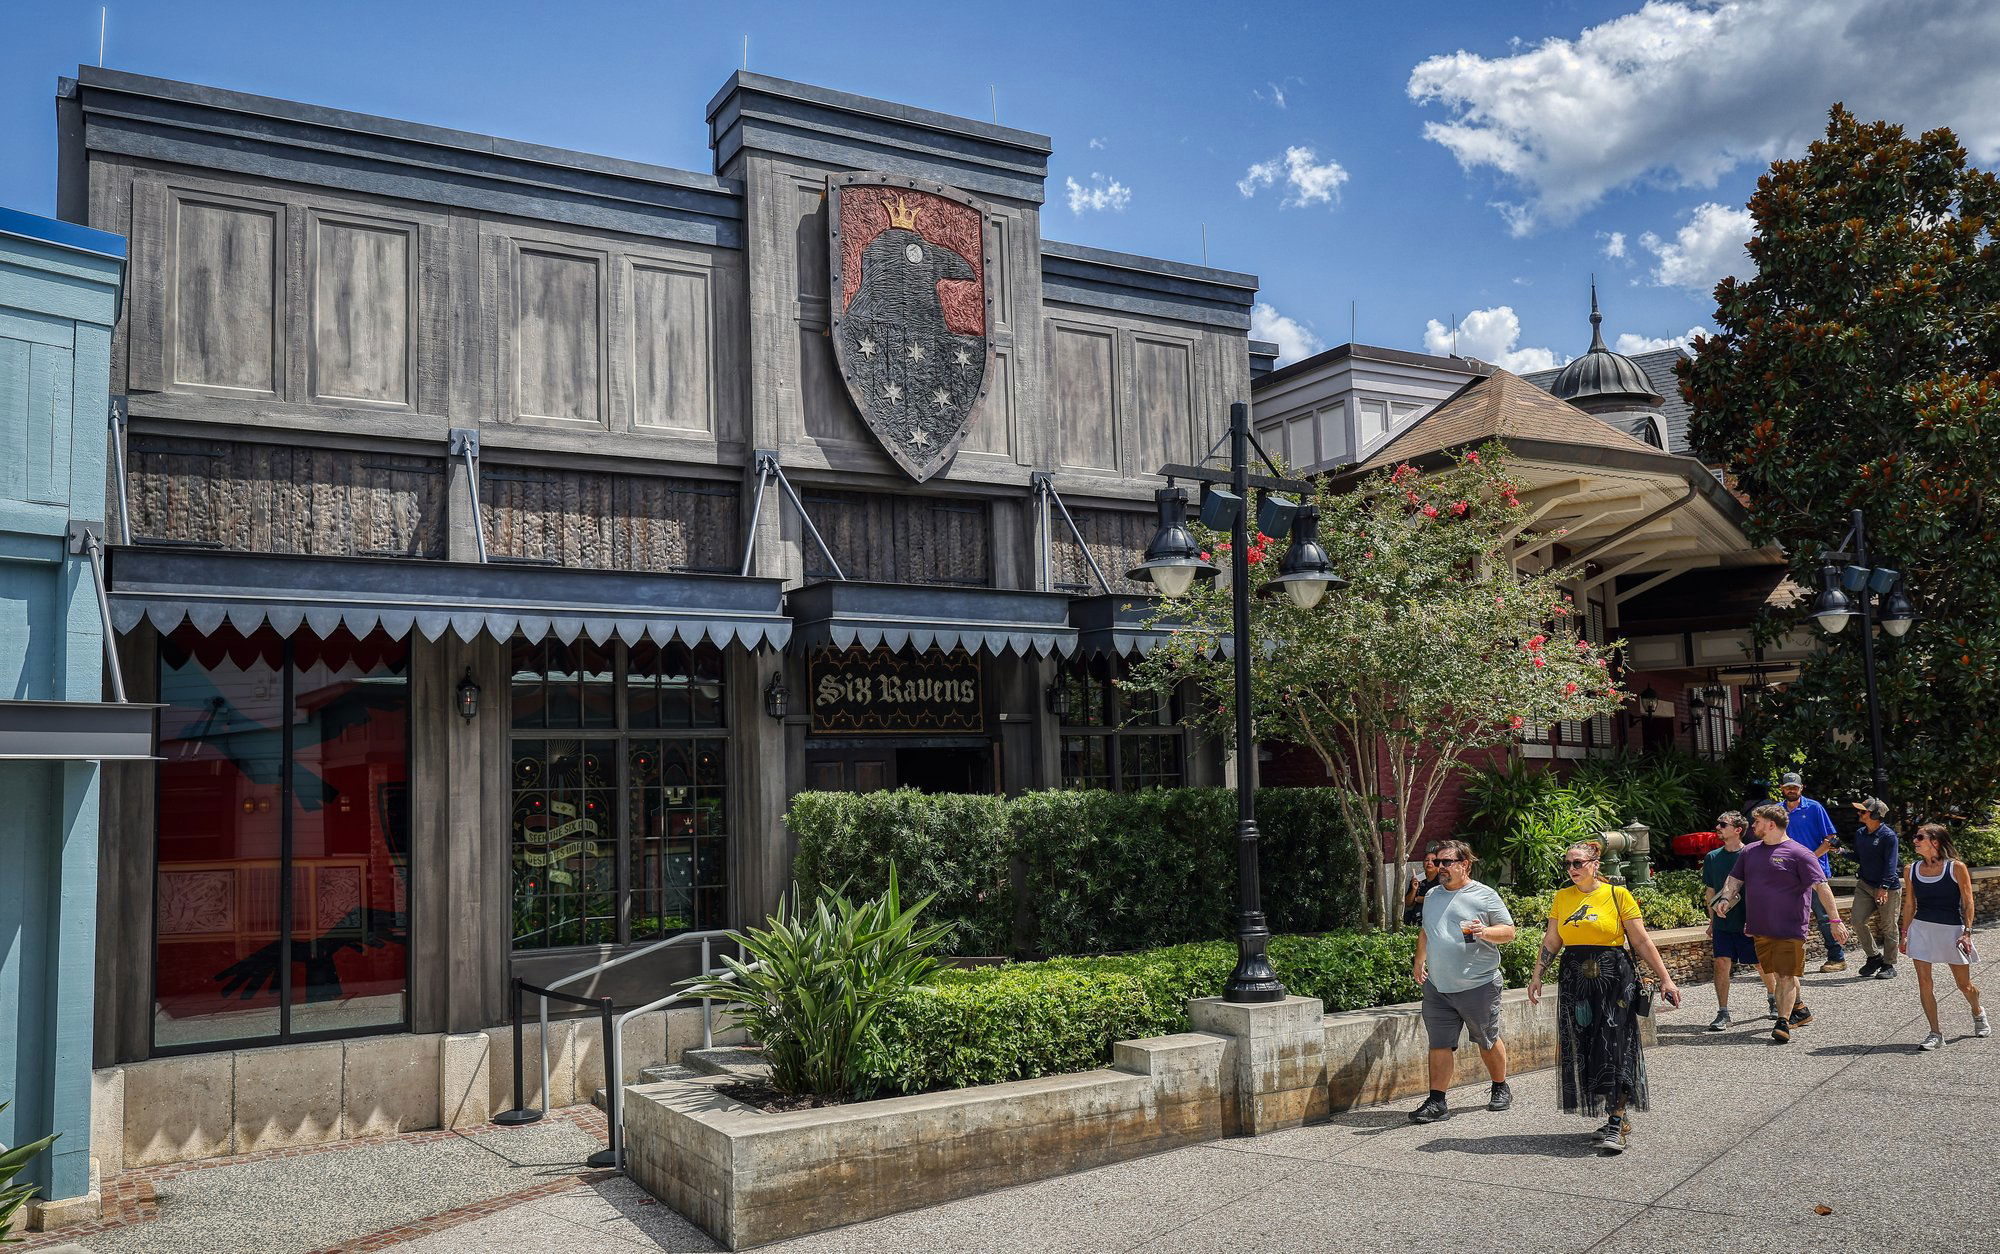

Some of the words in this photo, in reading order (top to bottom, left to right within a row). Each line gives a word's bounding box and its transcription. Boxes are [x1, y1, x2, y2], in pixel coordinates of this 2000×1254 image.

[816, 672, 872, 706] Six
[876, 673, 975, 703] Ravens
[549, 826, 563, 840] THE
[564, 821, 577, 834] SIX
[527, 849, 565, 865] DESTNIES
